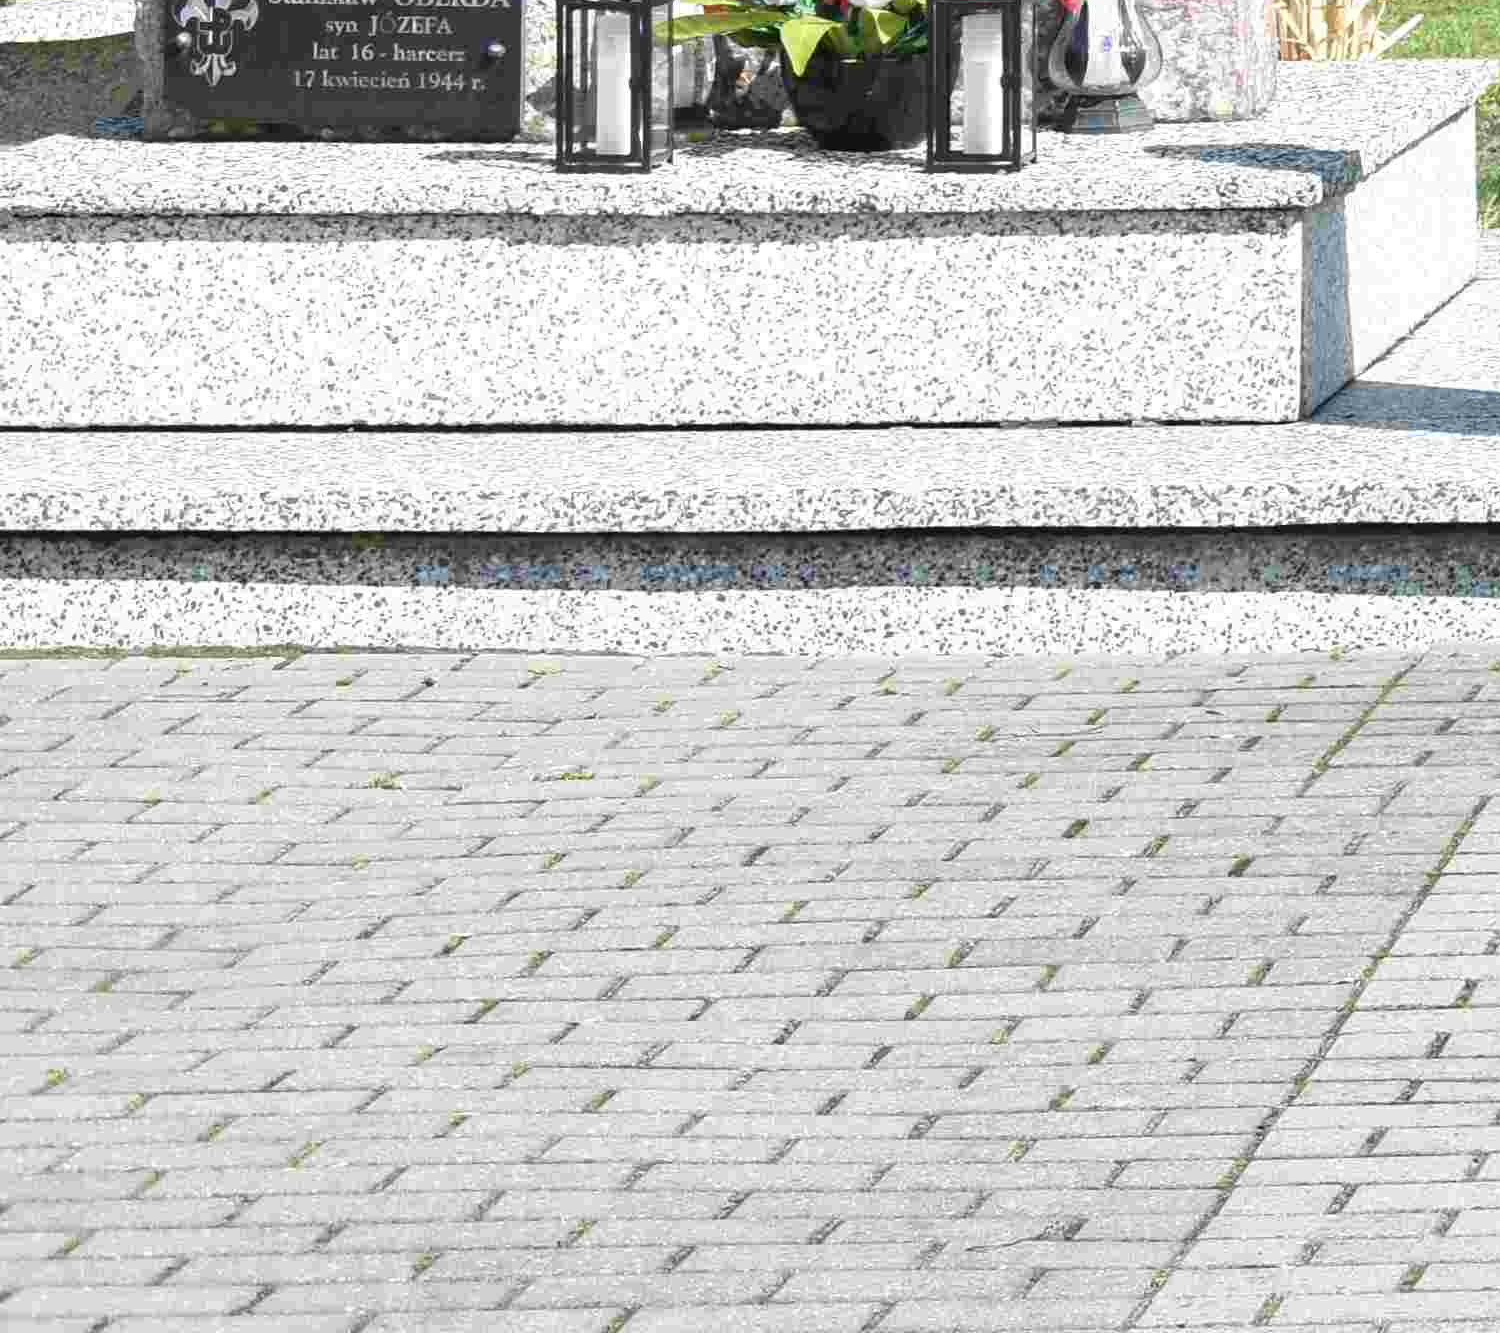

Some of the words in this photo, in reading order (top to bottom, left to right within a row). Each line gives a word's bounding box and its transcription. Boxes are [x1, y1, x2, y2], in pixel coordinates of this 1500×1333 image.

[326, 18, 359, 37] syn
[368, 12, 453, 37] JÓZEFA
[312, 41, 339, 62] lat
[352, 43, 374, 61] 16
[393, 42, 466, 62] harcerz
[292, 70, 314, 89] 17
[323, 70, 411, 90] kwiecień
[417, 71, 465, 91] 1944
